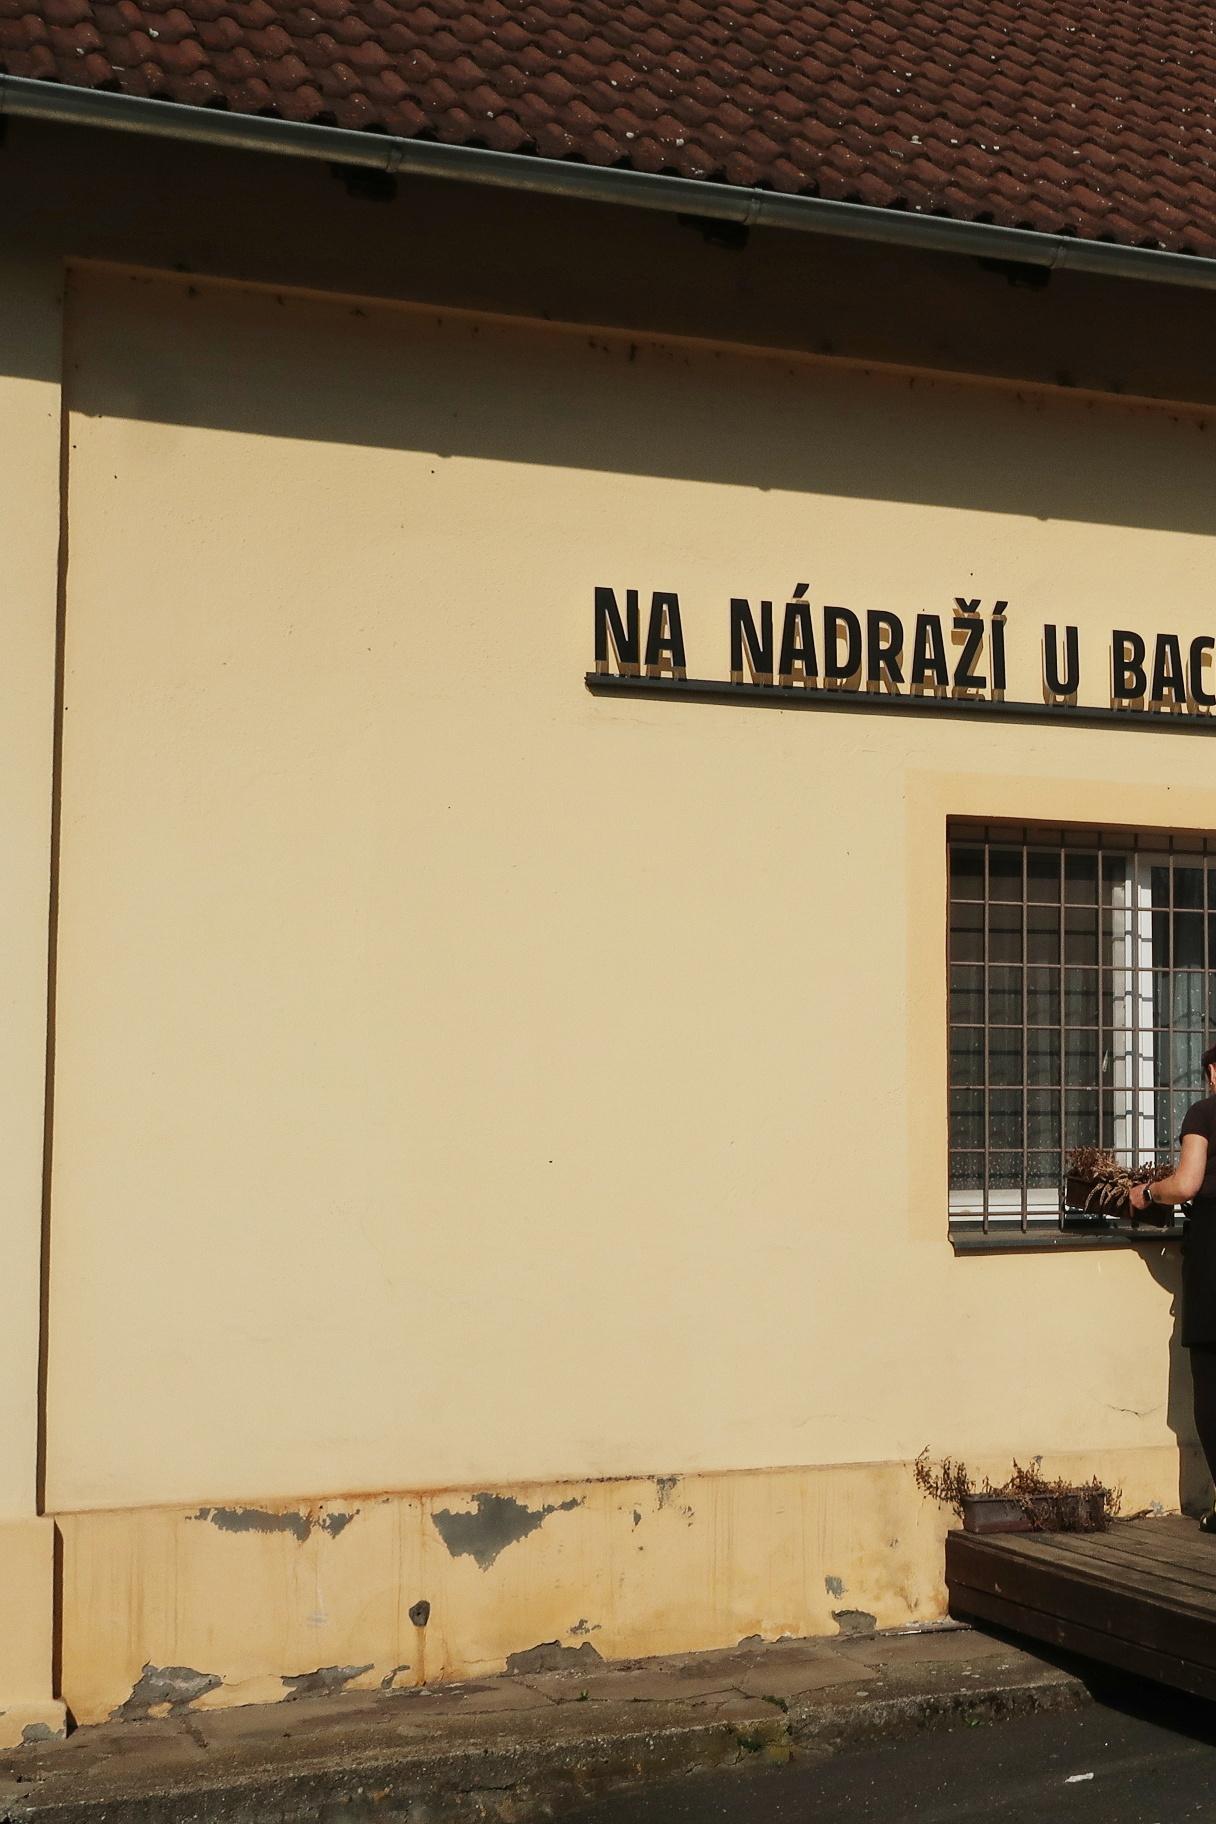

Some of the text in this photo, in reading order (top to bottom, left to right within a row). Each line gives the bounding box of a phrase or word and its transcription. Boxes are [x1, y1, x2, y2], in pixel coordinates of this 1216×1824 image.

[594, 586, 687, 668] NA
[729, 582, 1008, 690] NÁDRAŽÍ
[1043, 623, 1080, 696] U
